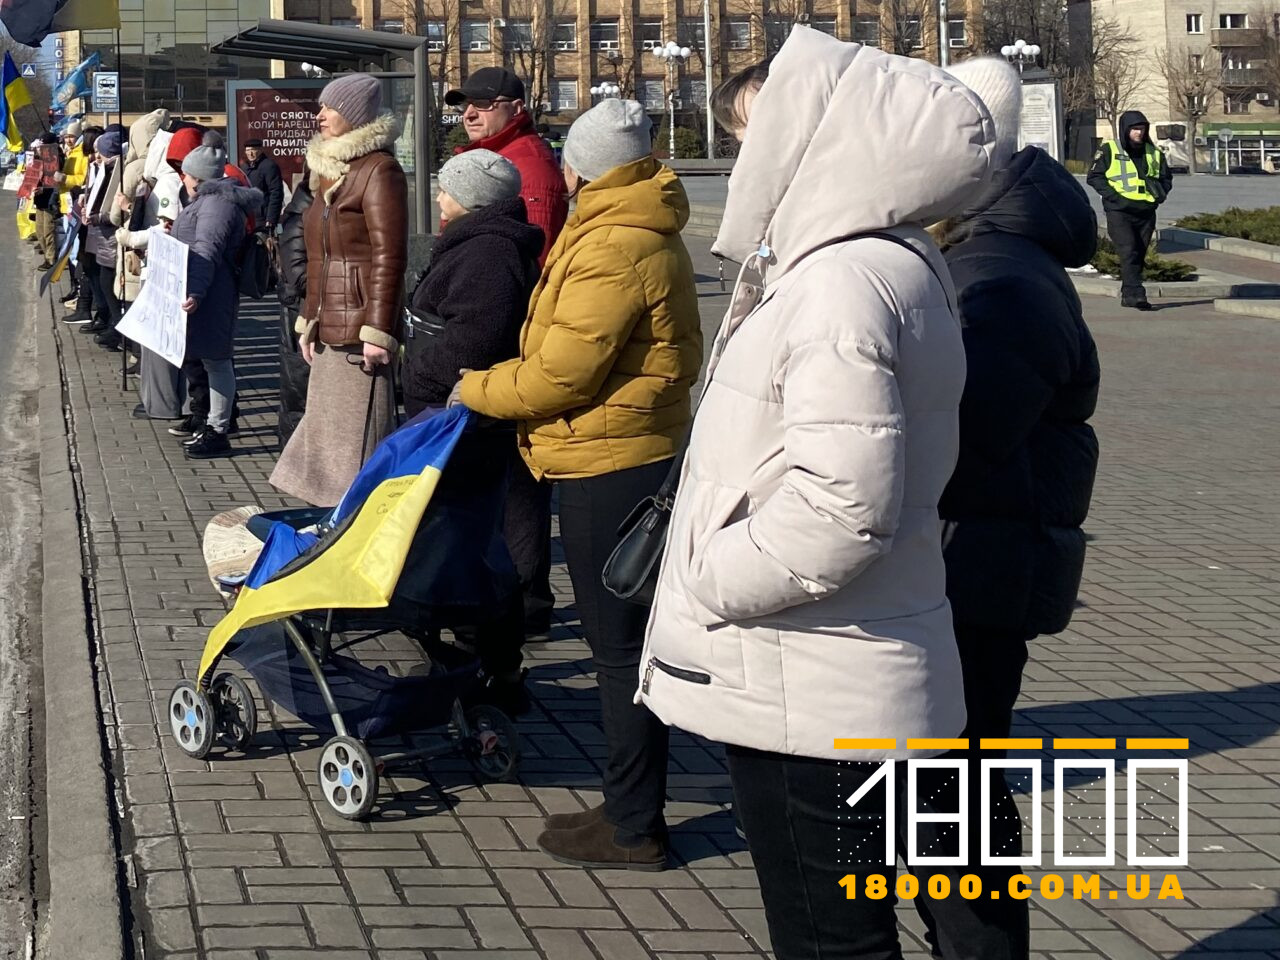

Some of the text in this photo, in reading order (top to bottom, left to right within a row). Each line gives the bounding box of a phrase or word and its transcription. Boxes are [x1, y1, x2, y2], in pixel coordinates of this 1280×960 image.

[261, 111, 316, 120] ОЧІ СЯЮТЬ
[248, 121, 275, 129] КОЛИ
[262, 139, 309, 147] ПРАВИЛЬ
[273, 148, 307, 156] ОКУЛЯ
